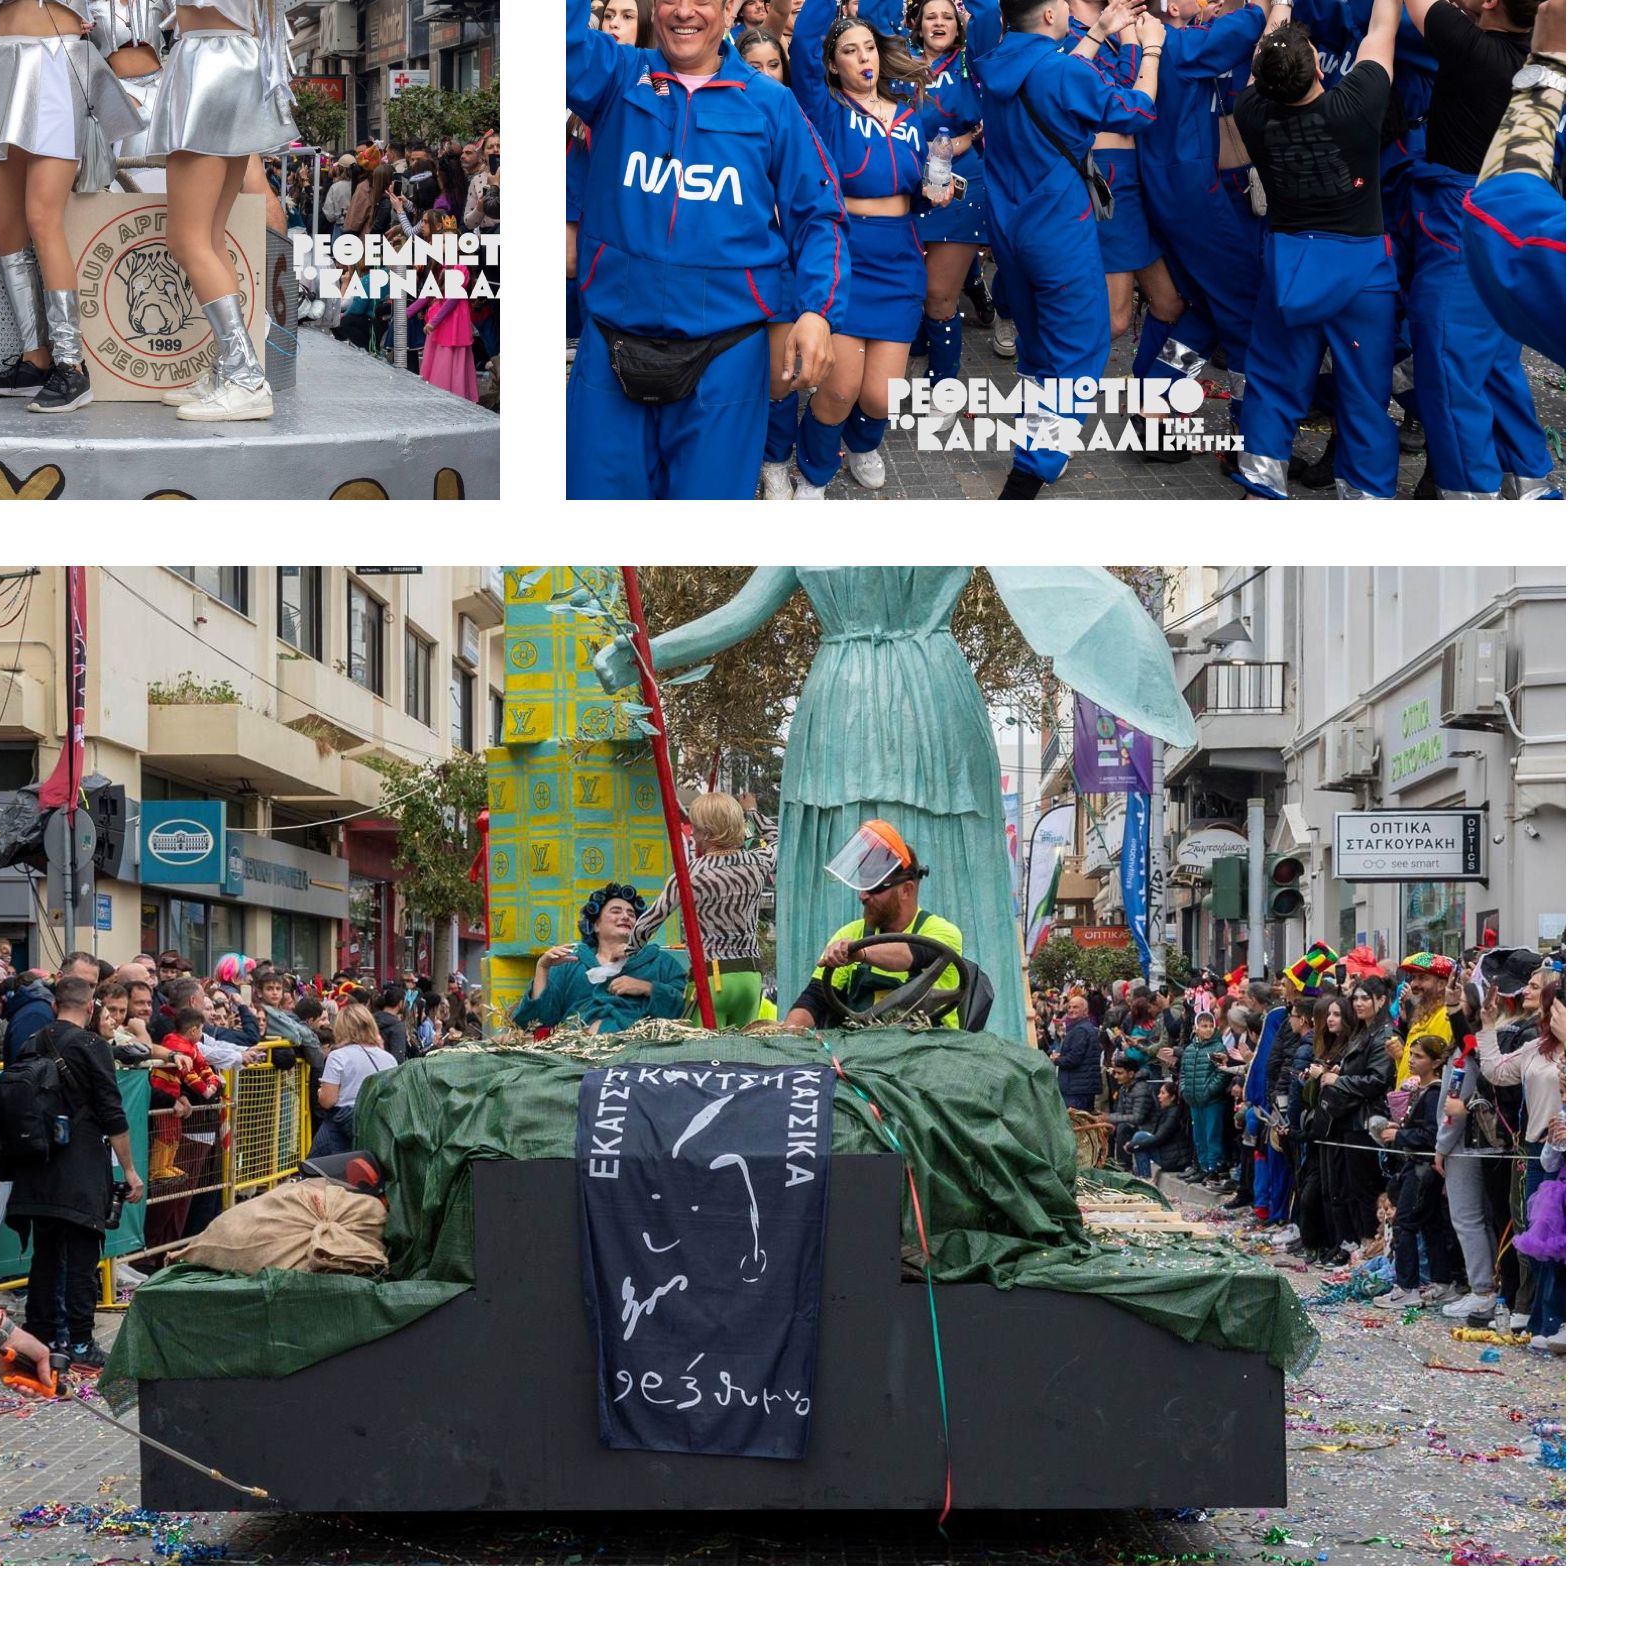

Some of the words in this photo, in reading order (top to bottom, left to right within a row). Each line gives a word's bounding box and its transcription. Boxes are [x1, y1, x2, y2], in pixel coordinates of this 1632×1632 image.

[850, 110, 920, 152] NASA
[623, 151, 743, 205] NASA
[81, 242, 115, 318] CLUB
[147, 339, 182, 352] 1989
[1346, 838, 1455, 850] ΣΤΑΓΚΟΥΡΑΚΗ
[1370, 822, 1432, 834] ΟΠΤΙΚΑ
[1467, 818, 1476, 870] OPTICS
[1391, 859, 1410, 868] see
[1411, 858, 1440, 868] smart
[785, 1070, 822, 1188] ΚΑΤΣΙΚΑ
